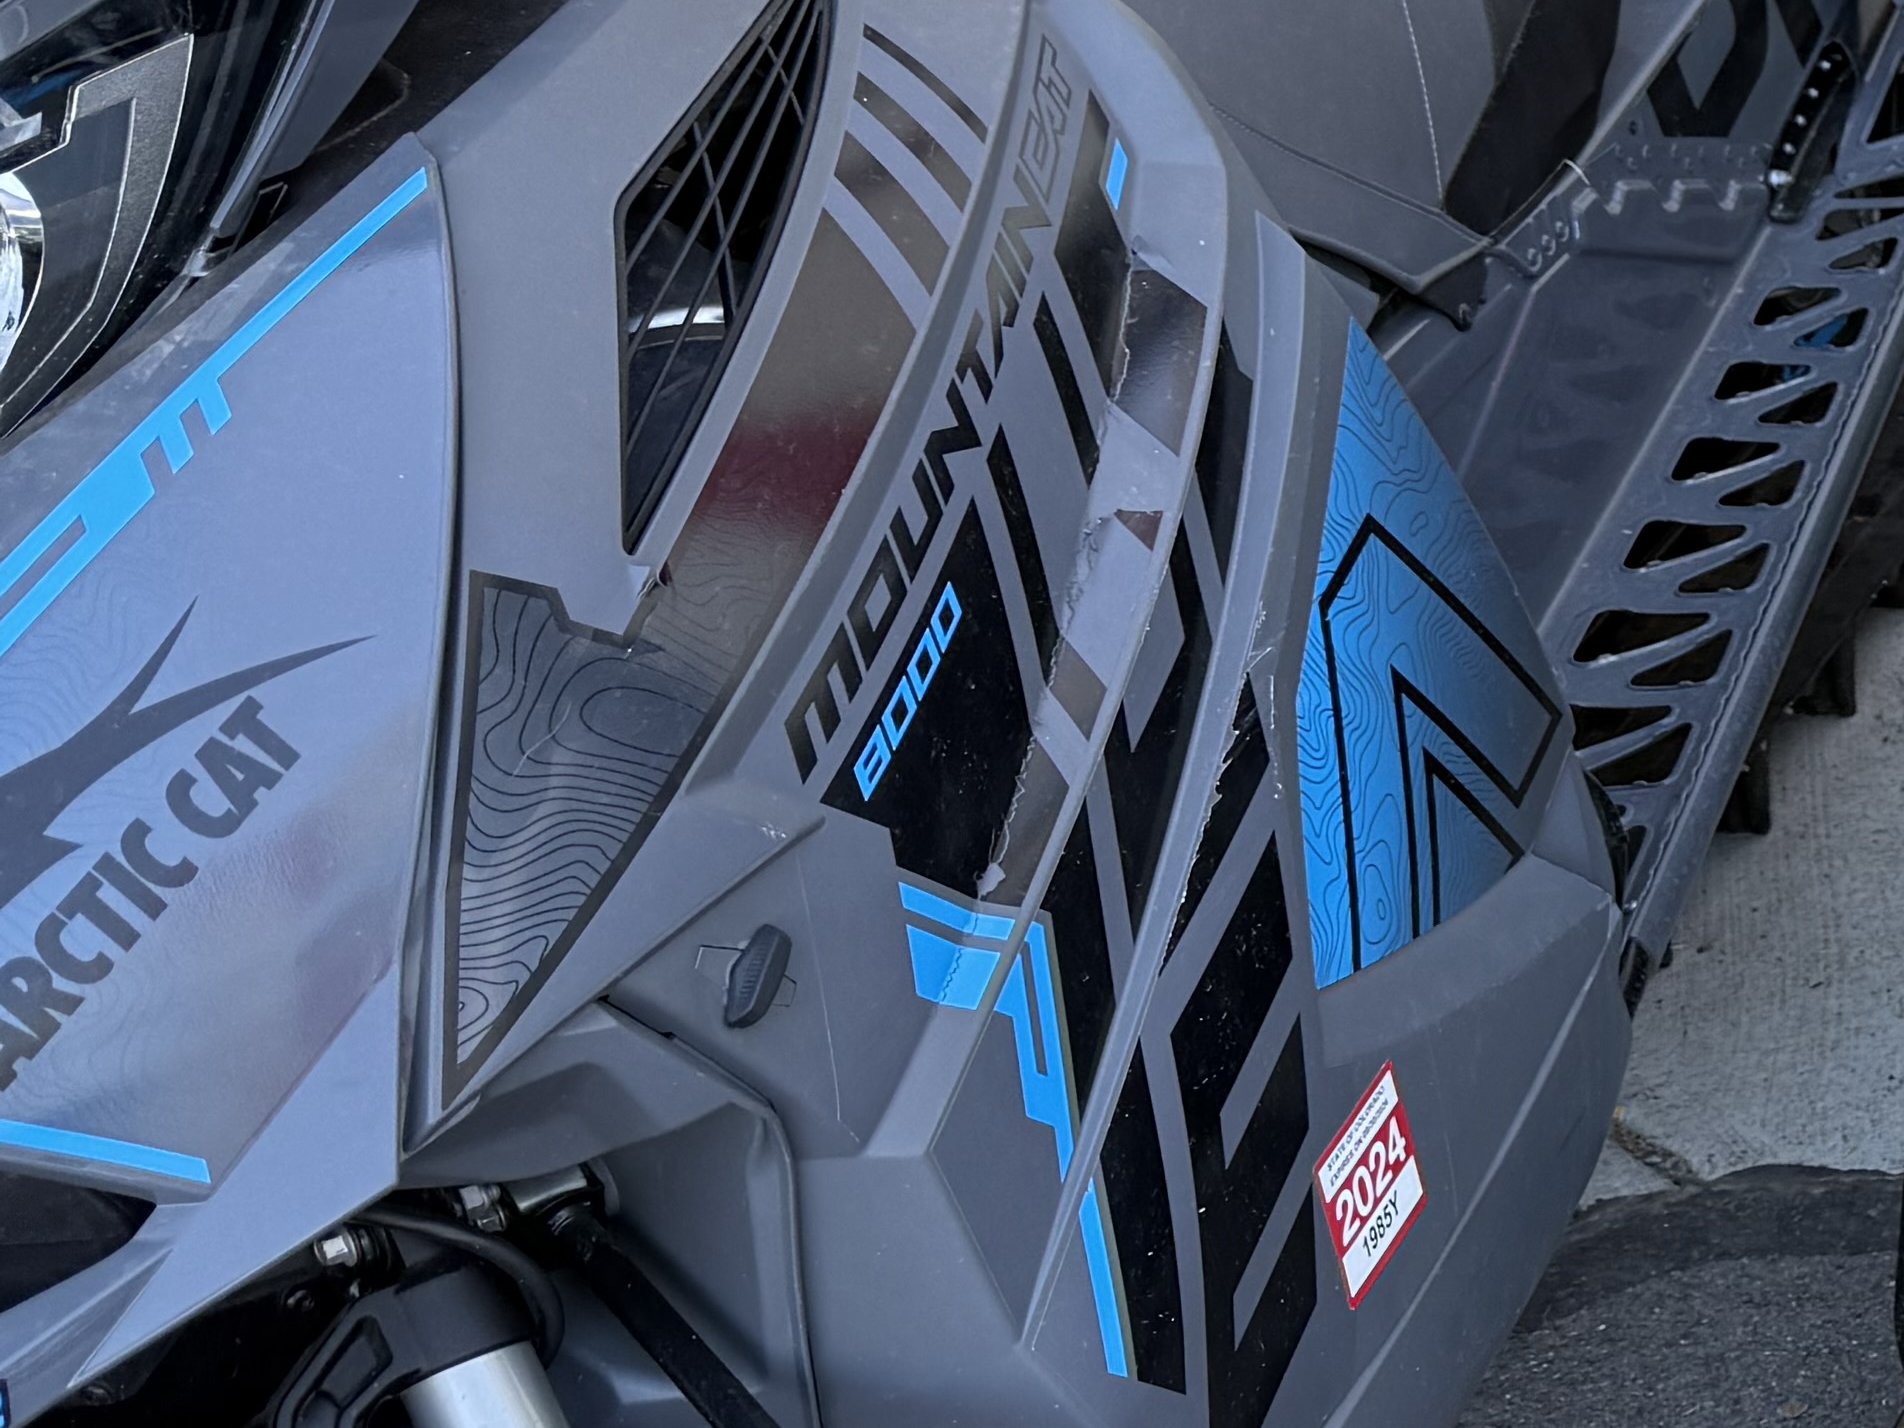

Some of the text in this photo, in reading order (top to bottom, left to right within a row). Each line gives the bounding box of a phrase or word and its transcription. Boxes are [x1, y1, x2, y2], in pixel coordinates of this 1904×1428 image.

[852, 580, 962, 801] 8000
[0, 694, 302, 1093] ARCTIC CAT
[1335, 1116, 1406, 1247] 2024
[1362, 1190, 1399, 1257] 1985Y
